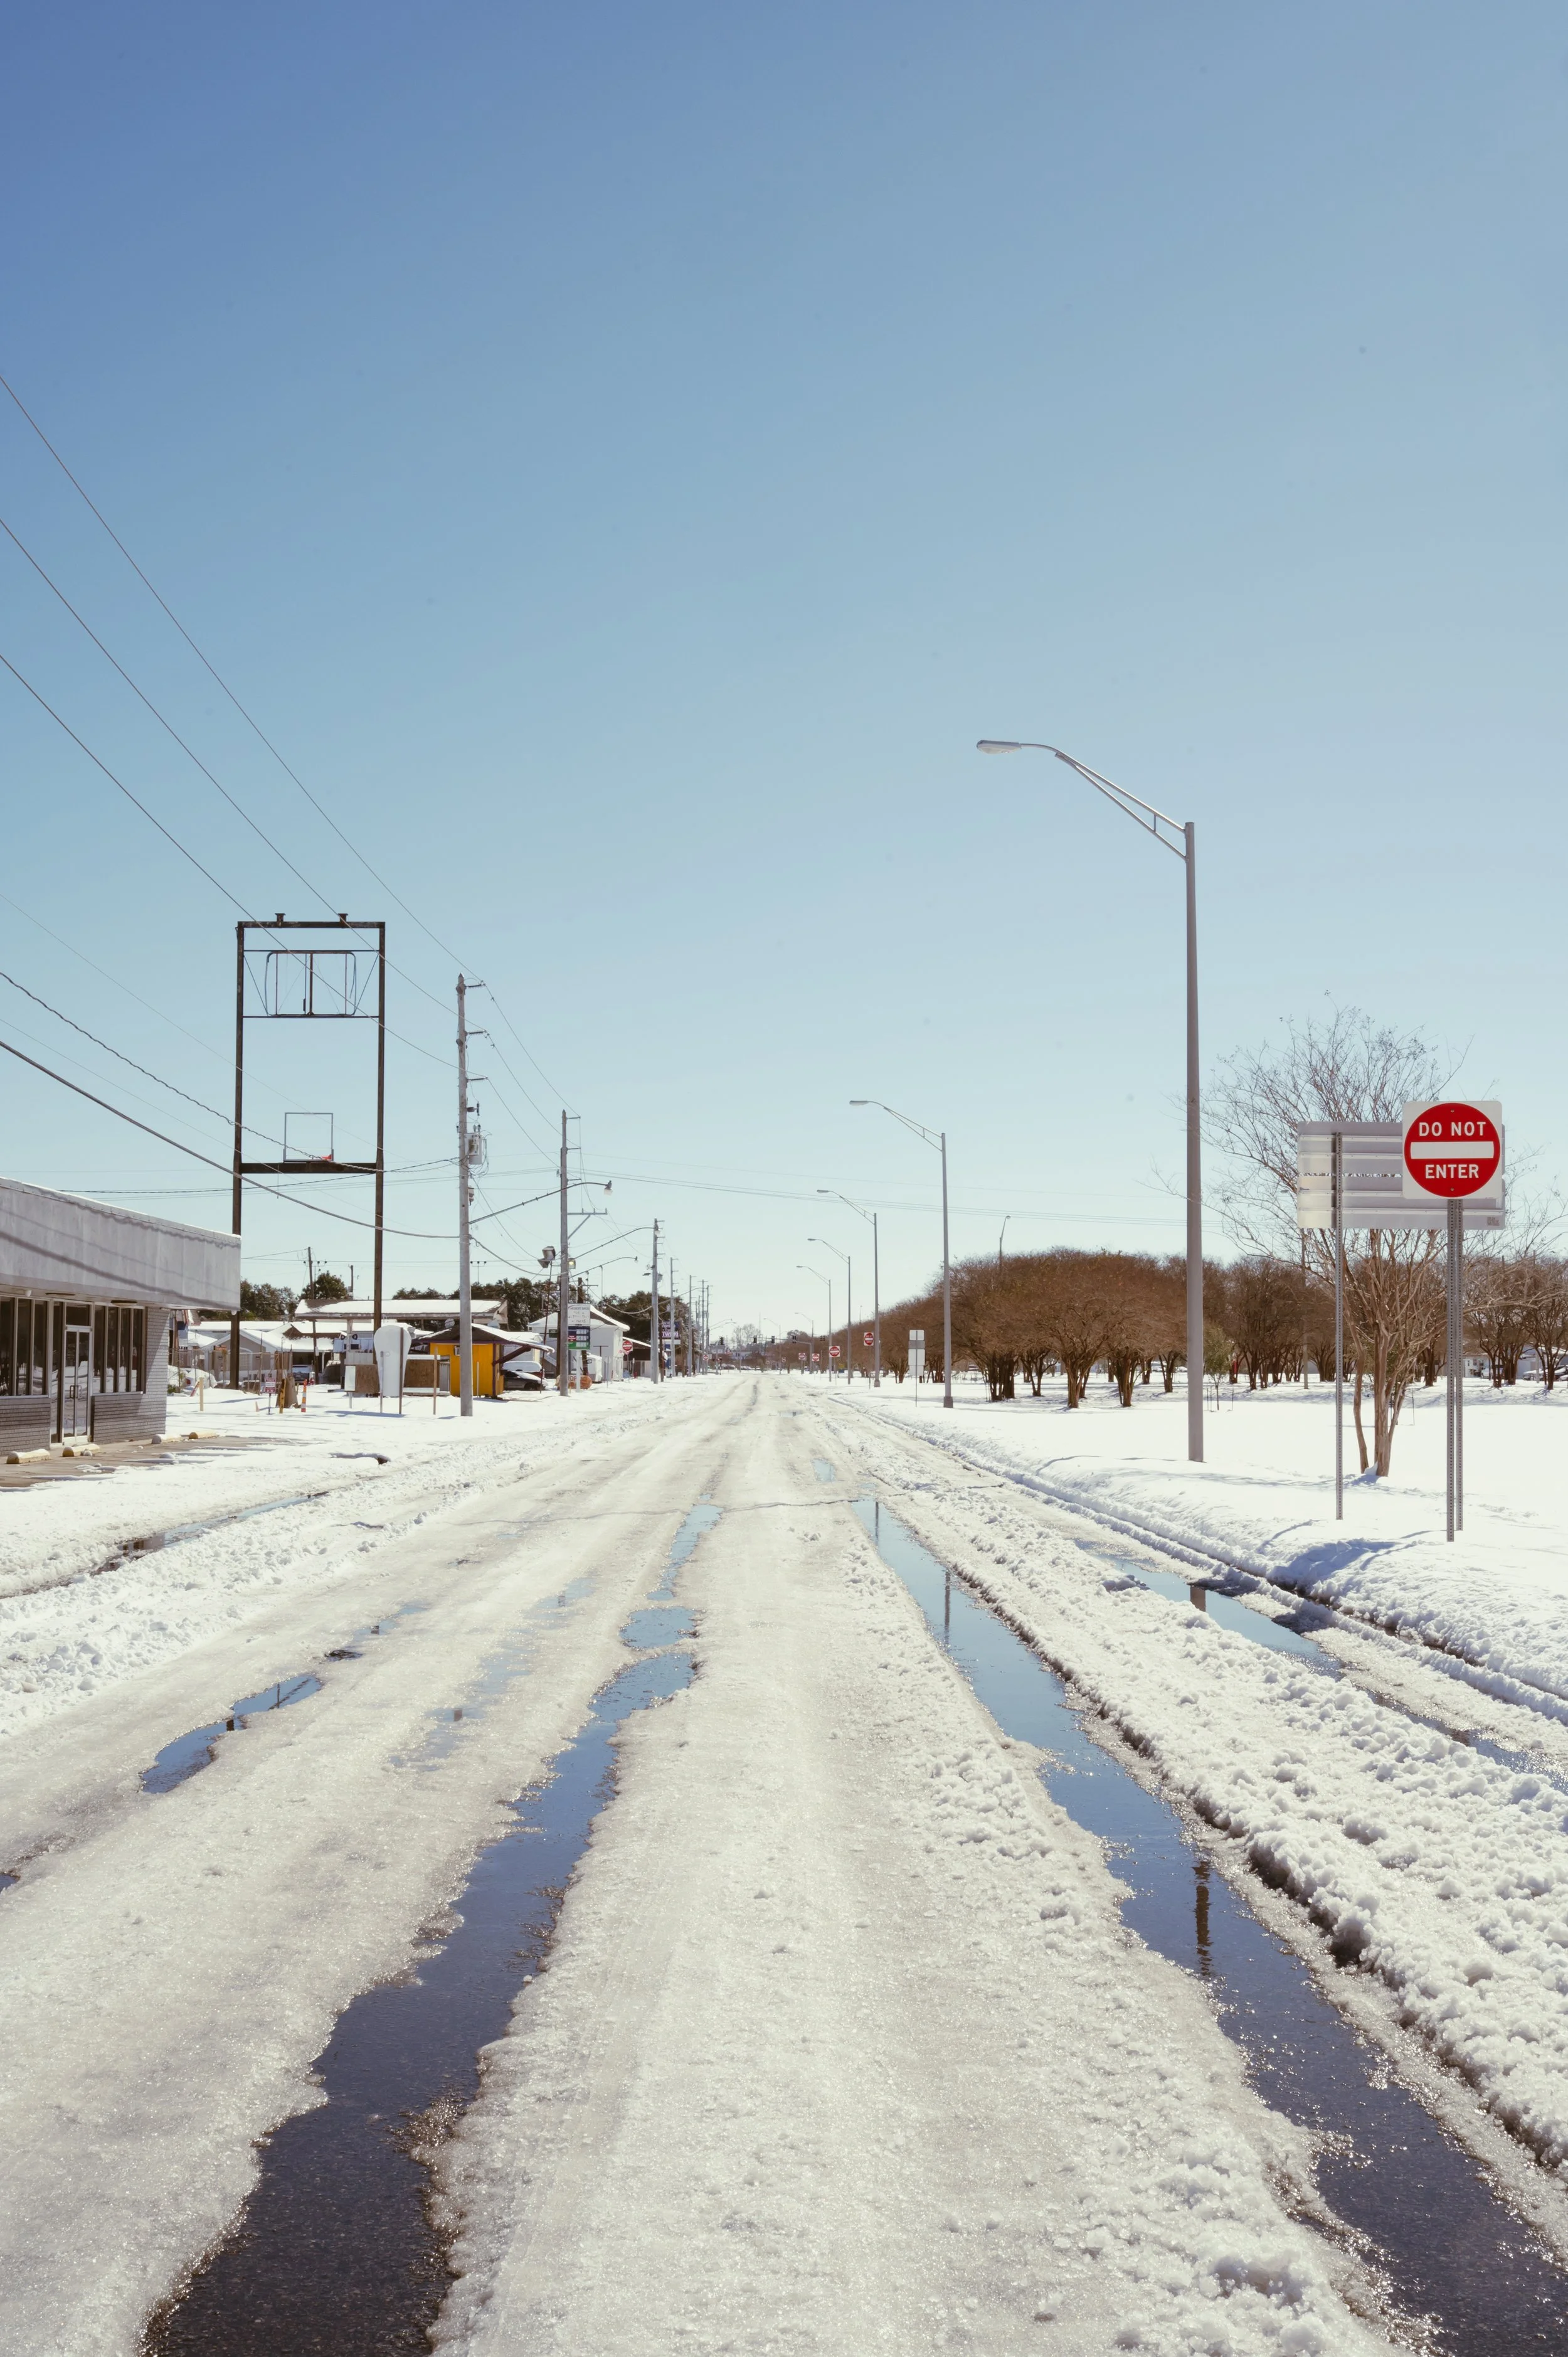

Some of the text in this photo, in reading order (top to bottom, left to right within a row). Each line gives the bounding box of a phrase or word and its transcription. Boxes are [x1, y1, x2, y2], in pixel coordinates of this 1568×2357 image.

[1419, 1121, 1486, 1137] DO NOT
[1425, 1164, 1479, 1179] ENTER
